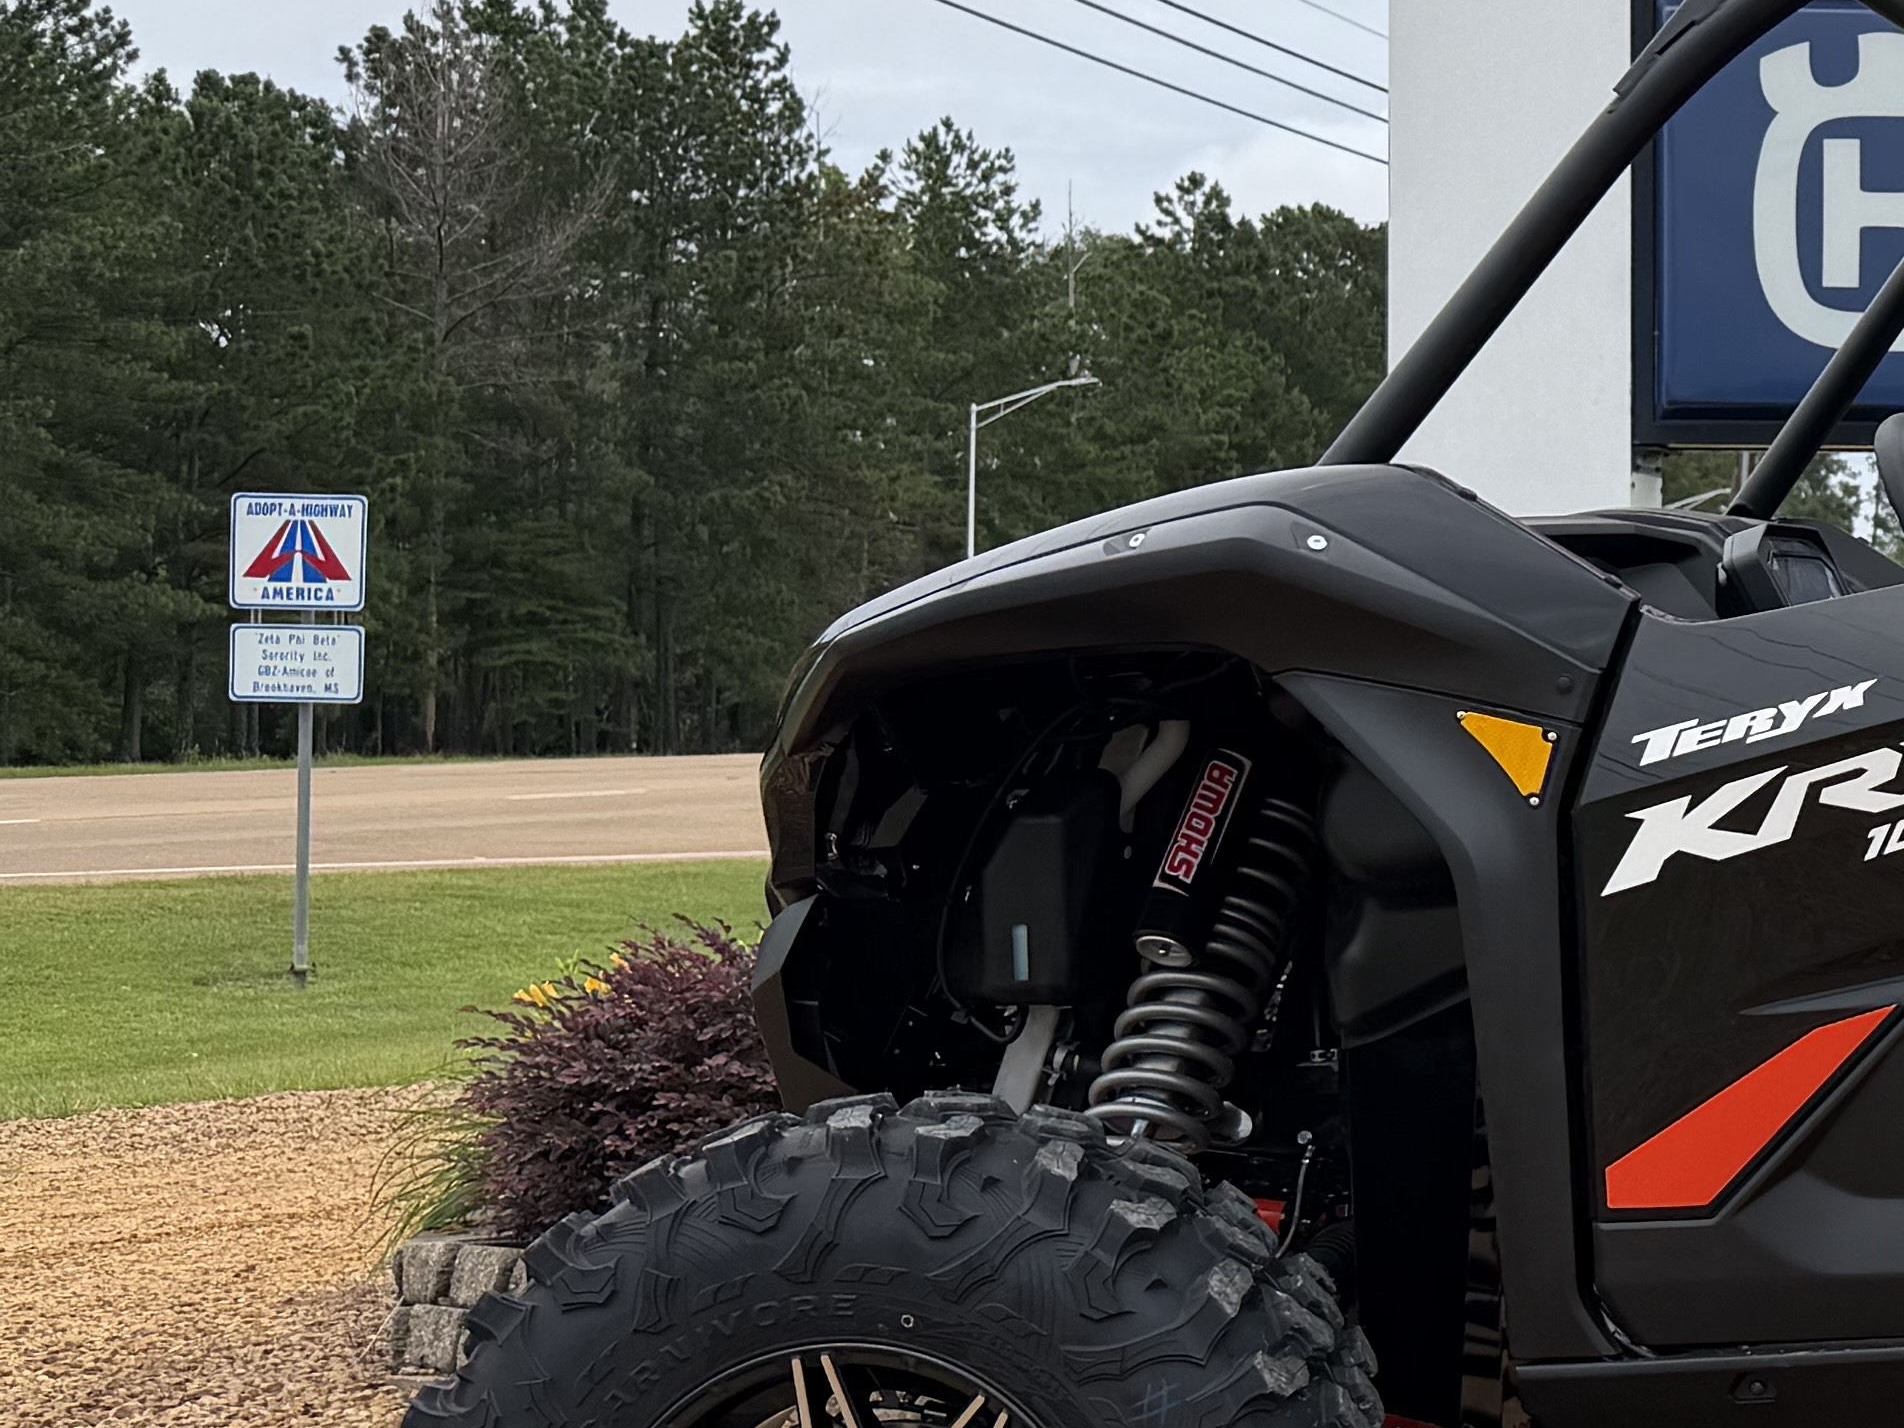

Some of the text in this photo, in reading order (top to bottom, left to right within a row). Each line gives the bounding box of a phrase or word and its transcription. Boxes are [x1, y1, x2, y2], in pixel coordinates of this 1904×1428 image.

[246, 501, 353, 518] ADOPT-A-HIGHWAY
[261, 586, 334, 601] AMERICA
[1165, 760, 1238, 884] SHOWA
